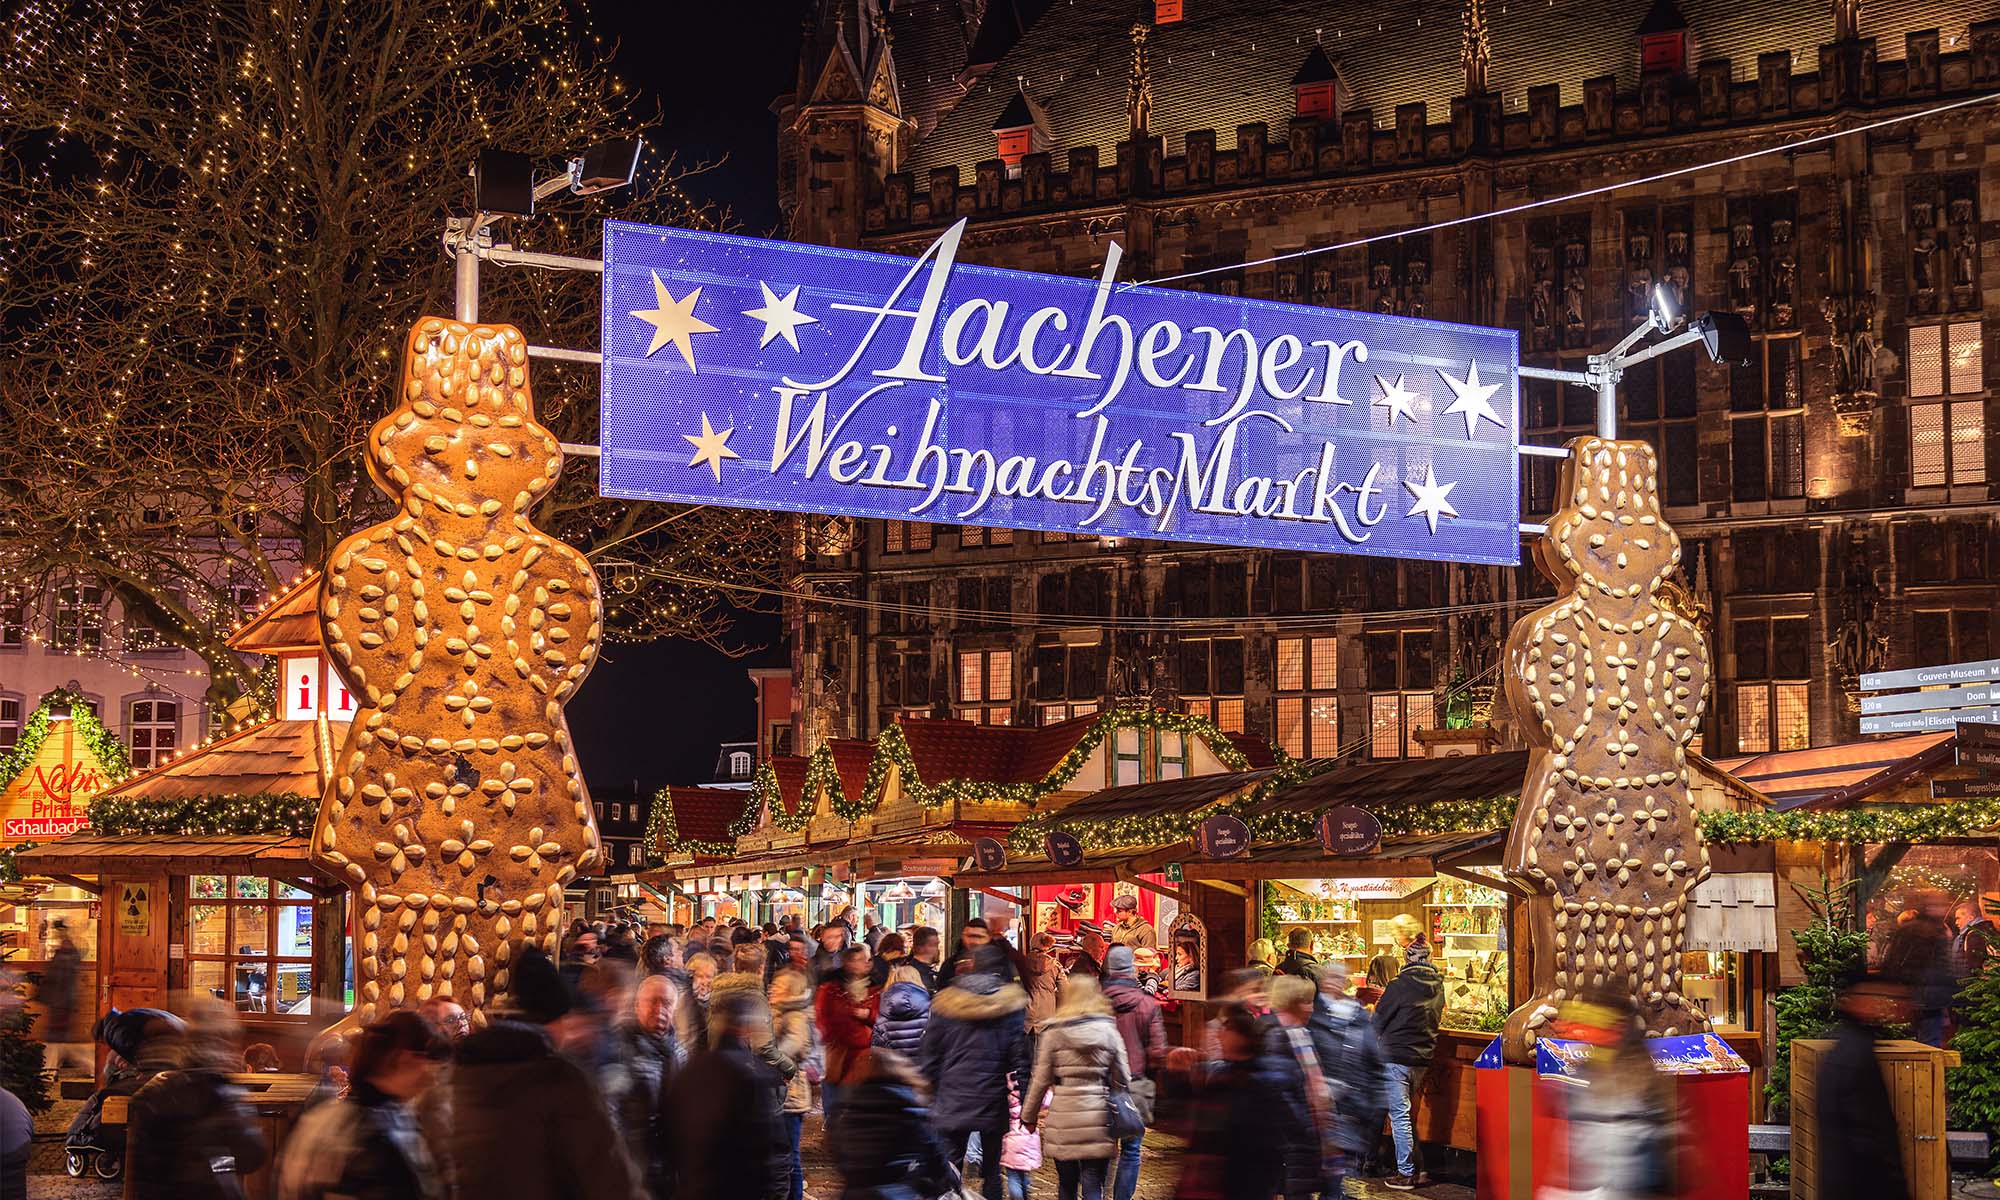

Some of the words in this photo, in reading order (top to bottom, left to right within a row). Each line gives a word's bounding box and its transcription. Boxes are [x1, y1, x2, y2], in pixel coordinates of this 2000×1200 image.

[782, 217, 1368, 426] Aachener
[1917, 669, 1985, 682] Couven-Museum
[1863, 678, 1874, 687] 140
[1966, 692, 1986, 701] Dom
[1863, 702, 1875, 710] 320
[19, 761, 104, 803] Nobis
